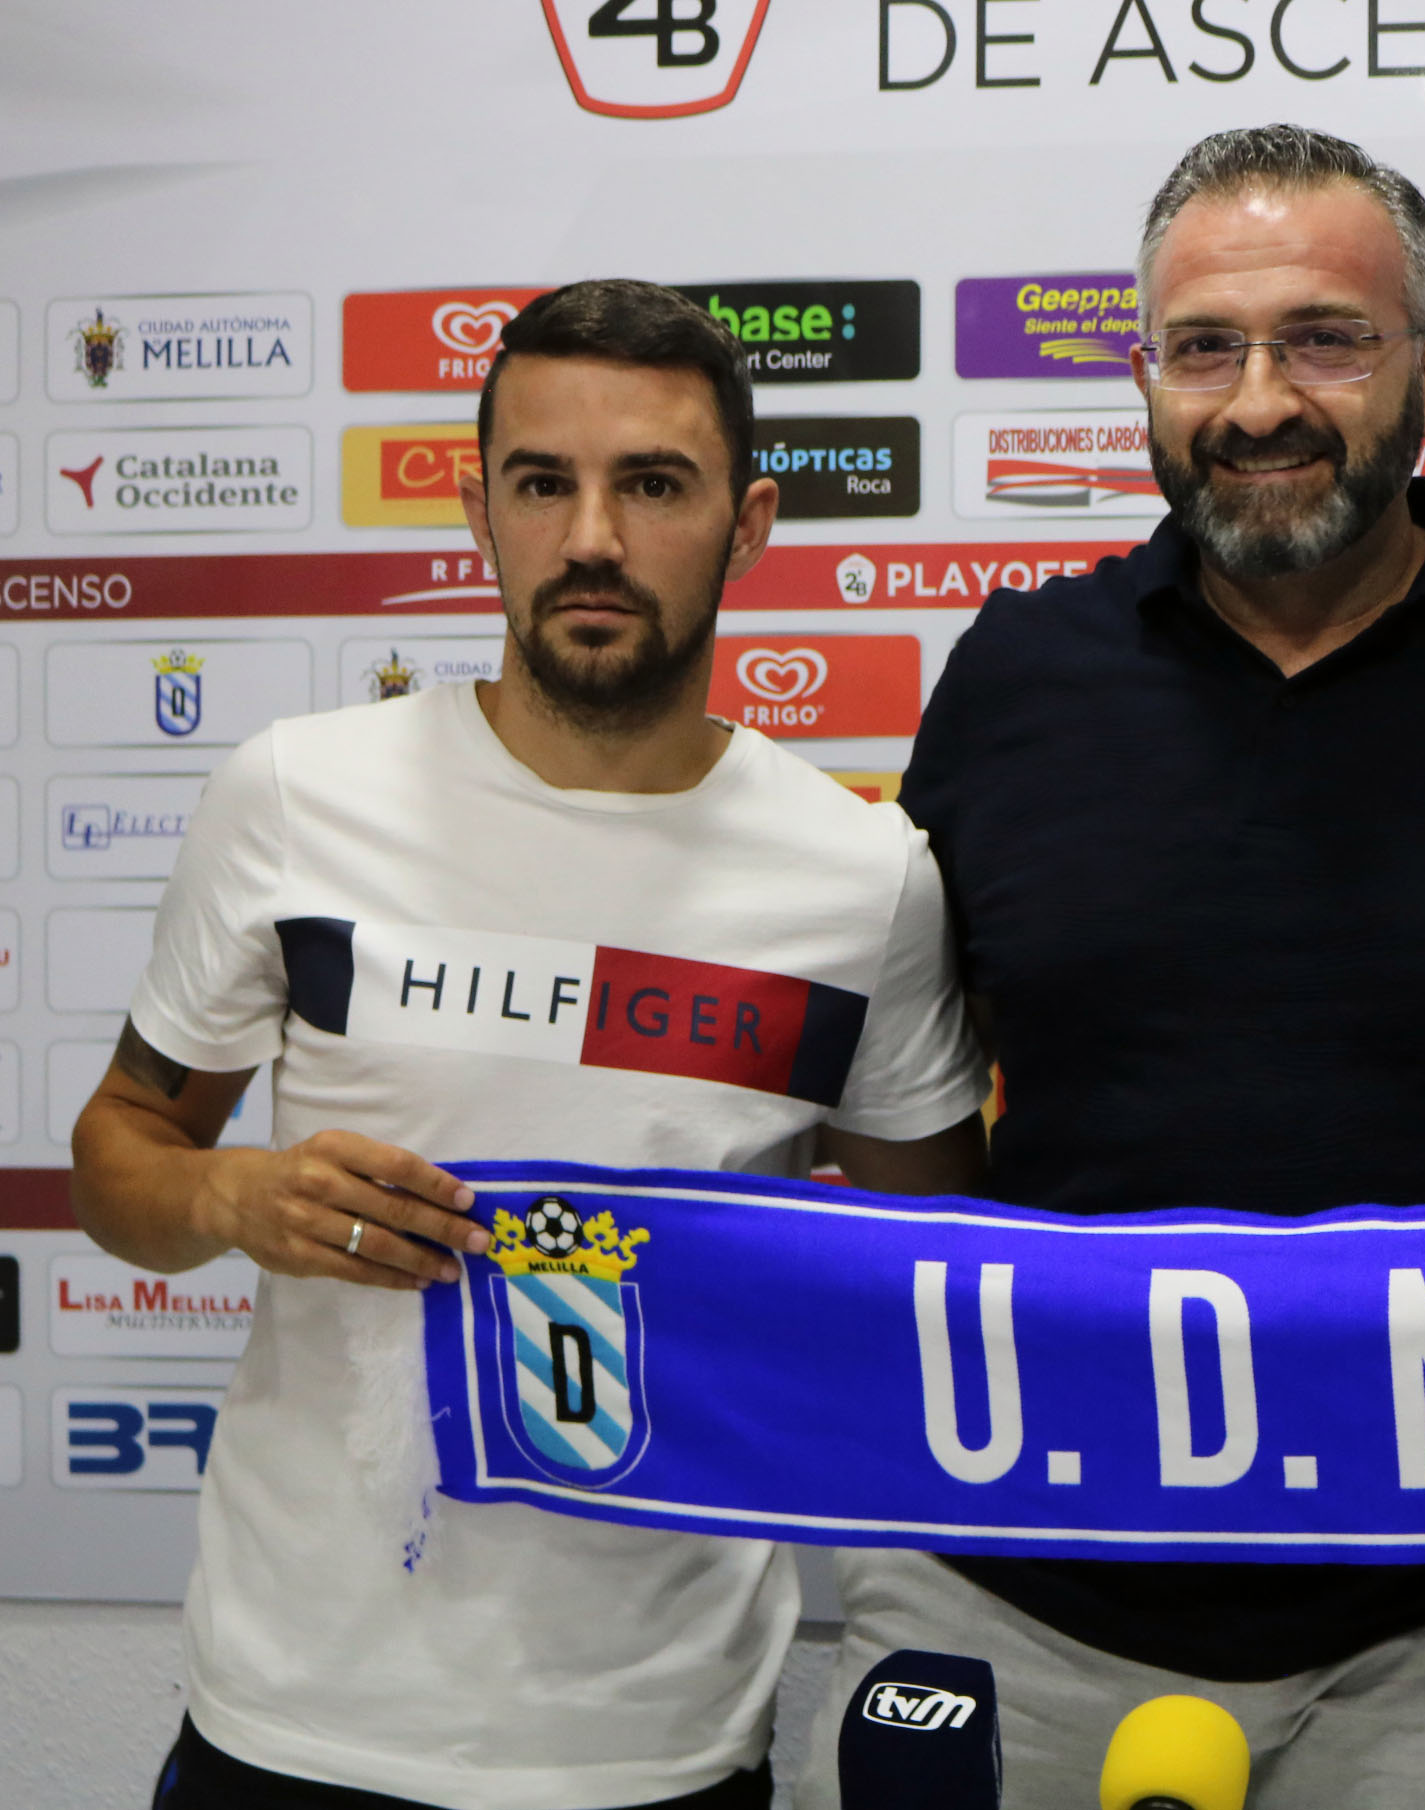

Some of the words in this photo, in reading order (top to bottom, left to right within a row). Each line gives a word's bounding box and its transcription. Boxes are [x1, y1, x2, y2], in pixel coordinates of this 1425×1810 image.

[878, 0, 1042, 91] DE
[1016, 283, 1139, 317] Geeppa
[138, 319, 195, 334] CIUDAD
[199, 316, 291, 333] AUTÓNOMA
[1024, 317, 1078, 335] Siente
[1081, 316, 1098, 334] el
[1100, 316, 1140, 337] depo
[142, 336, 293, 371] MELILLA
[765, 349, 833, 370] Center
[438, 357, 491, 379] FRIG
[988, 427, 1094, 455] DISTRIBUCIONES
[115, 451, 280, 480] Catalana
[115, 481, 299, 510] Occidente
[846, 475, 892, 494] Roca
[431, 558, 498, 582] RFE
[0, 573, 133, 611] CENSO
[434, 661, 493, 676] CIUDAD
[743, 705, 820, 726] FRIGO
[398, 958, 764, 1056] HILFIGER
[527, 1261, 590, 1276] MELILLA
[548, 1321, 597, 1424] D
[913, 1260, 1082, 1485] U.
[1148, 1267, 1319, 1490] D.
[875, 1685, 977, 1730] tvm
